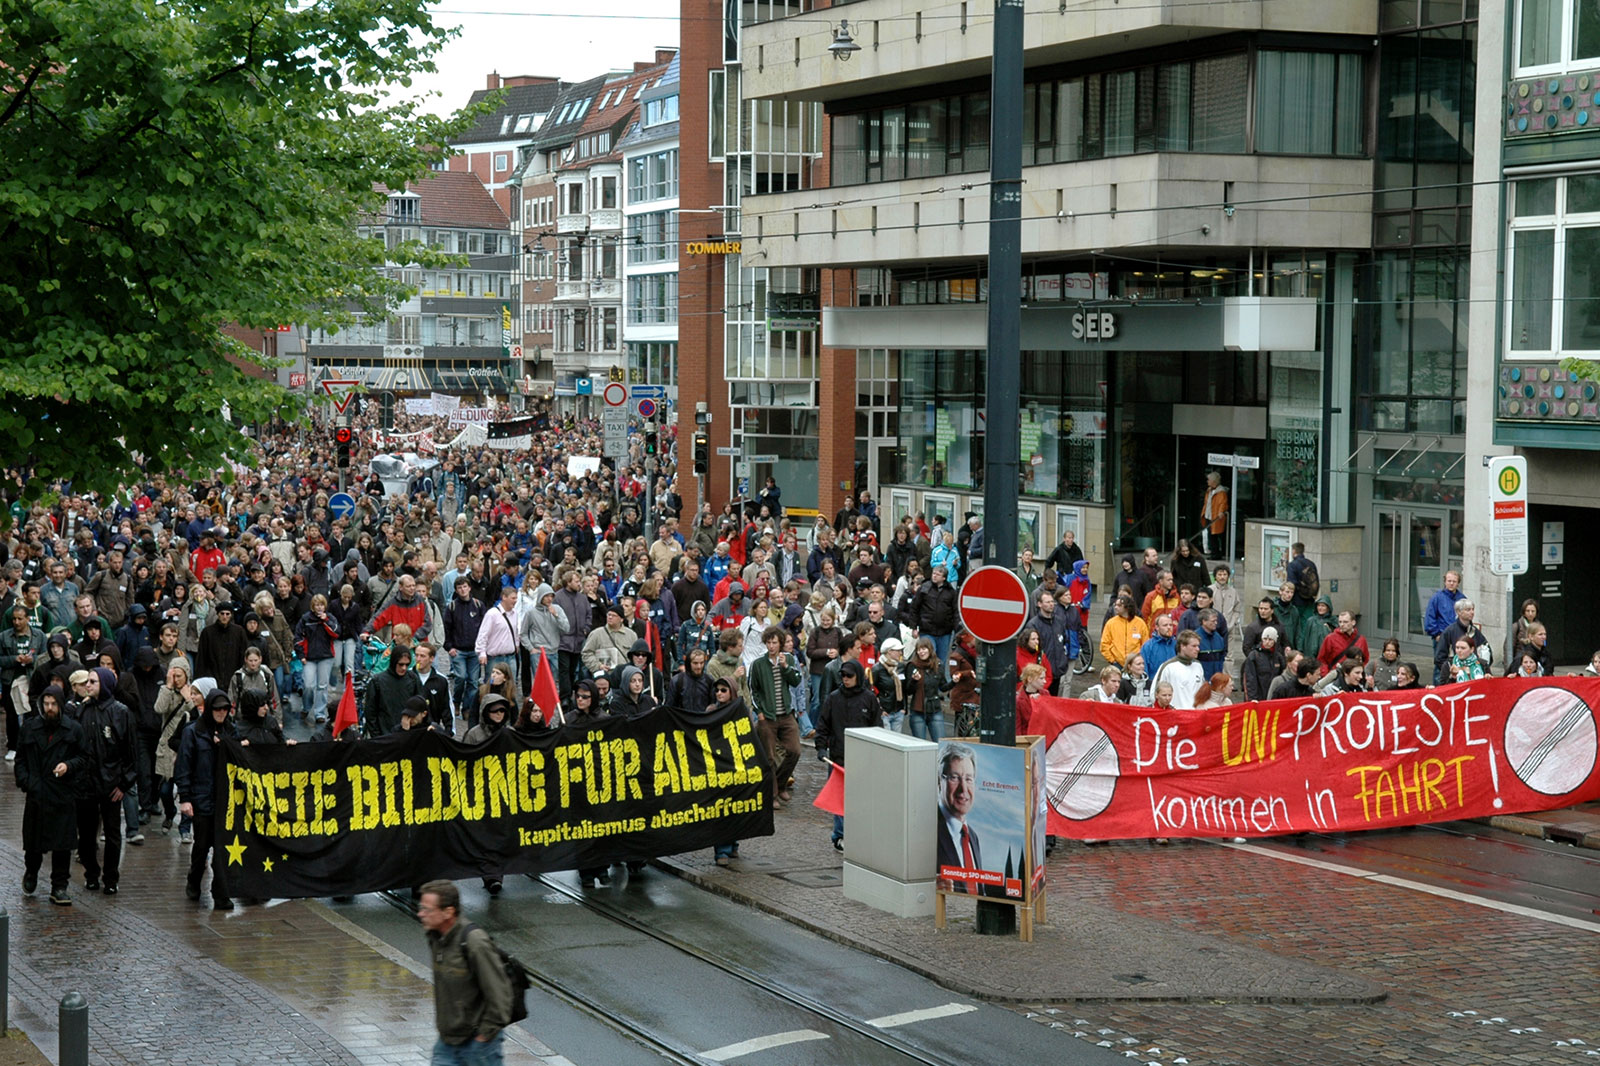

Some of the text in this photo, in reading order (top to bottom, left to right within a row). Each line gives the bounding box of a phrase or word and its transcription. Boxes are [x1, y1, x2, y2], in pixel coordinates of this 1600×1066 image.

[686, 242, 741, 254] COMMER
[776, 298, 815, 312] SEB
[502, 305, 512, 350] SUBWAY
[1071, 312, 1115, 339] SEB
[451, 408, 494, 422] BILDUNG
[606, 423, 625, 432] TAXI
[1276, 430, 1316, 445] SEB BANK
[1276, 446, 1315, 460] SEB BANK
[1504, 472, 1515, 490] H
[1133, 687, 1489, 772] Die UNI-PROTESTE
[226, 716, 763, 838] FREIE BILDUNG FÜR ALLE
[1147, 777, 1291, 833] kommen
[1305, 780, 1339, 829] in
[1346, 755, 1476, 822] FAHRT
[518, 791, 763, 847] kapitalismus abschaffen!
[943, 869, 1002, 882] Sonntag: SPD wählen!
[1007, 887, 1020, 896] SPD
